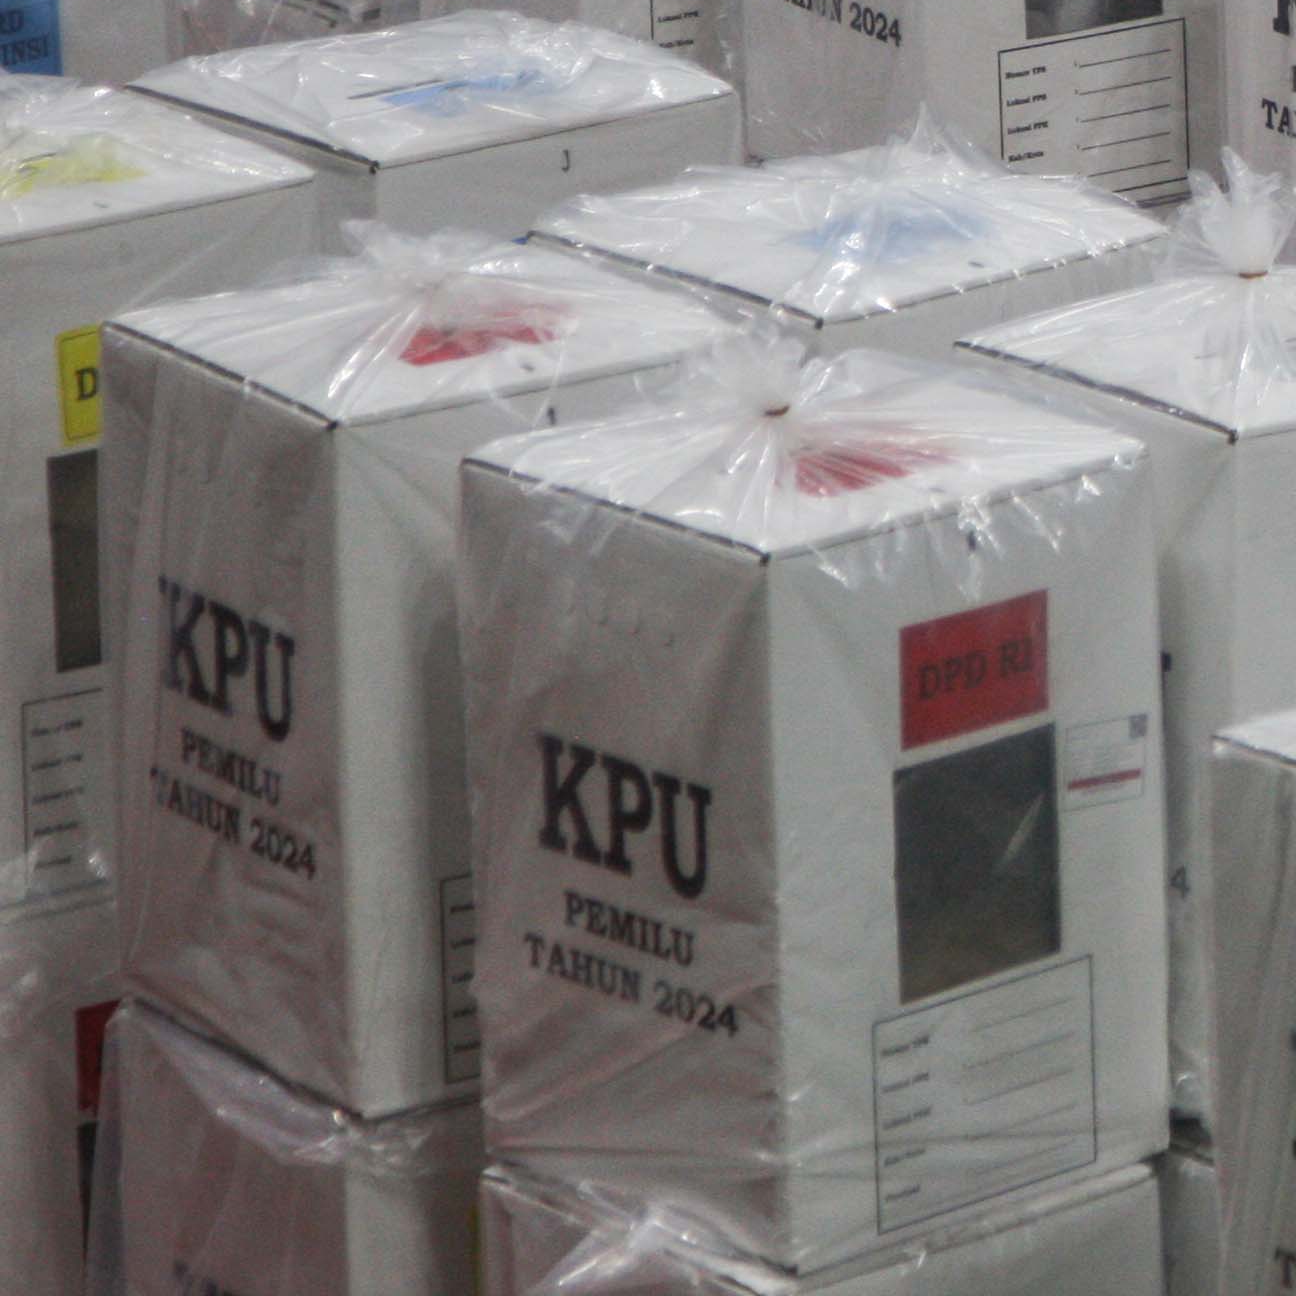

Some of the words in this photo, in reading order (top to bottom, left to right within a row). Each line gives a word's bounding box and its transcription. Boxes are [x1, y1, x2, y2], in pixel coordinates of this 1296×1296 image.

[849, 3, 902, 48] 2024
[158, 574, 295, 741] KPU
[917, 651, 989, 701] DPD
[997, 636, 1037, 679] RI
[180, 728, 281, 806] PEMILU
[149, 768, 240, 845] TAHUN
[250, 826, 317, 881] 2024
[537, 732, 712, 900] KPU
[563, 890, 694, 967] PEMILU
[525, 932, 643, 1005] TAHUN
[653, 978, 739, 1038] 2024
